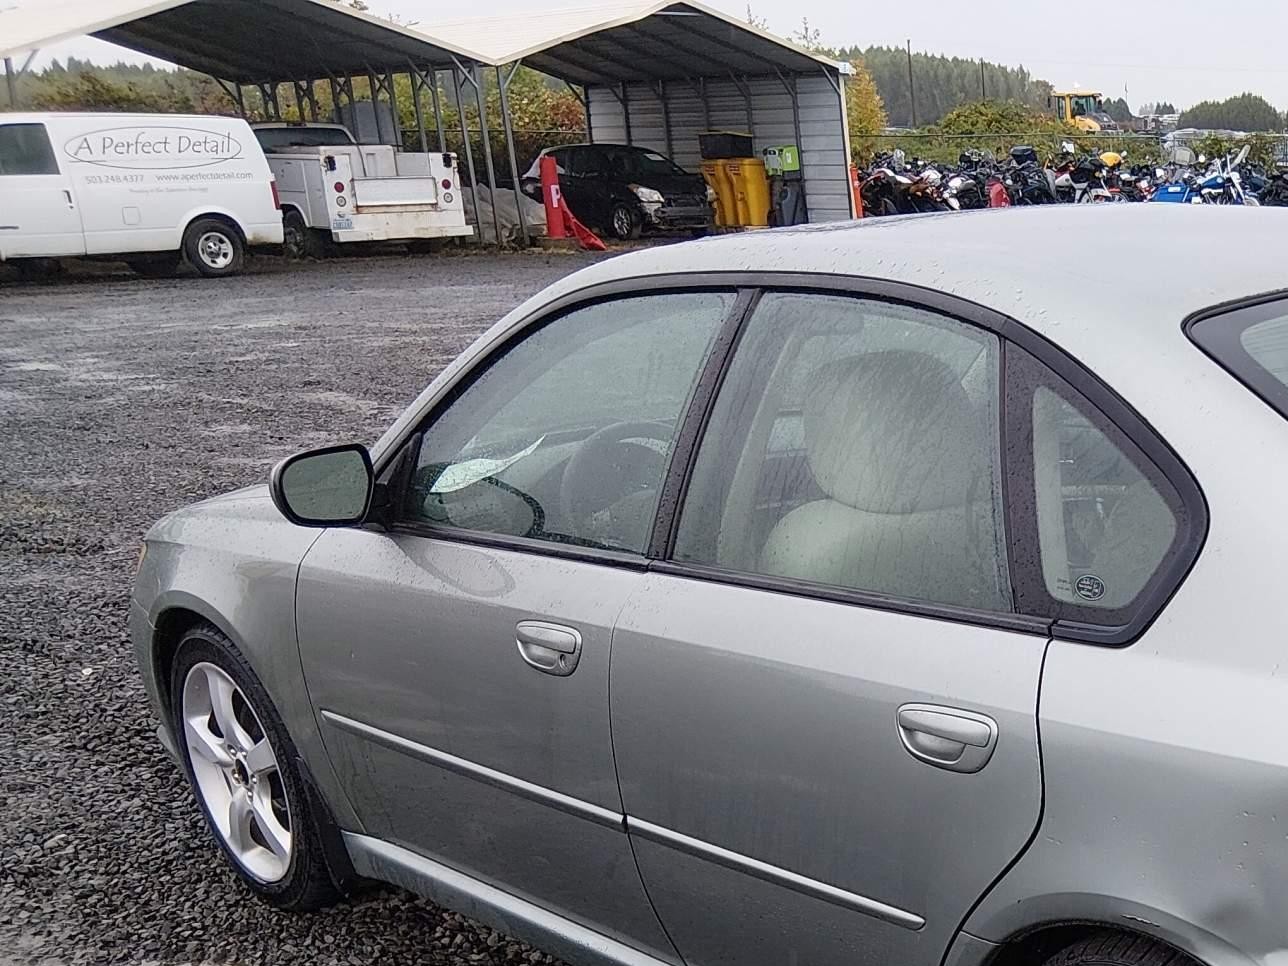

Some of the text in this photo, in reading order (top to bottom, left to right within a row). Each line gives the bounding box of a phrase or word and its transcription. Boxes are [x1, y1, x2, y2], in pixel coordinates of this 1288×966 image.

[74, 131, 232, 157] A Perfect Detail
